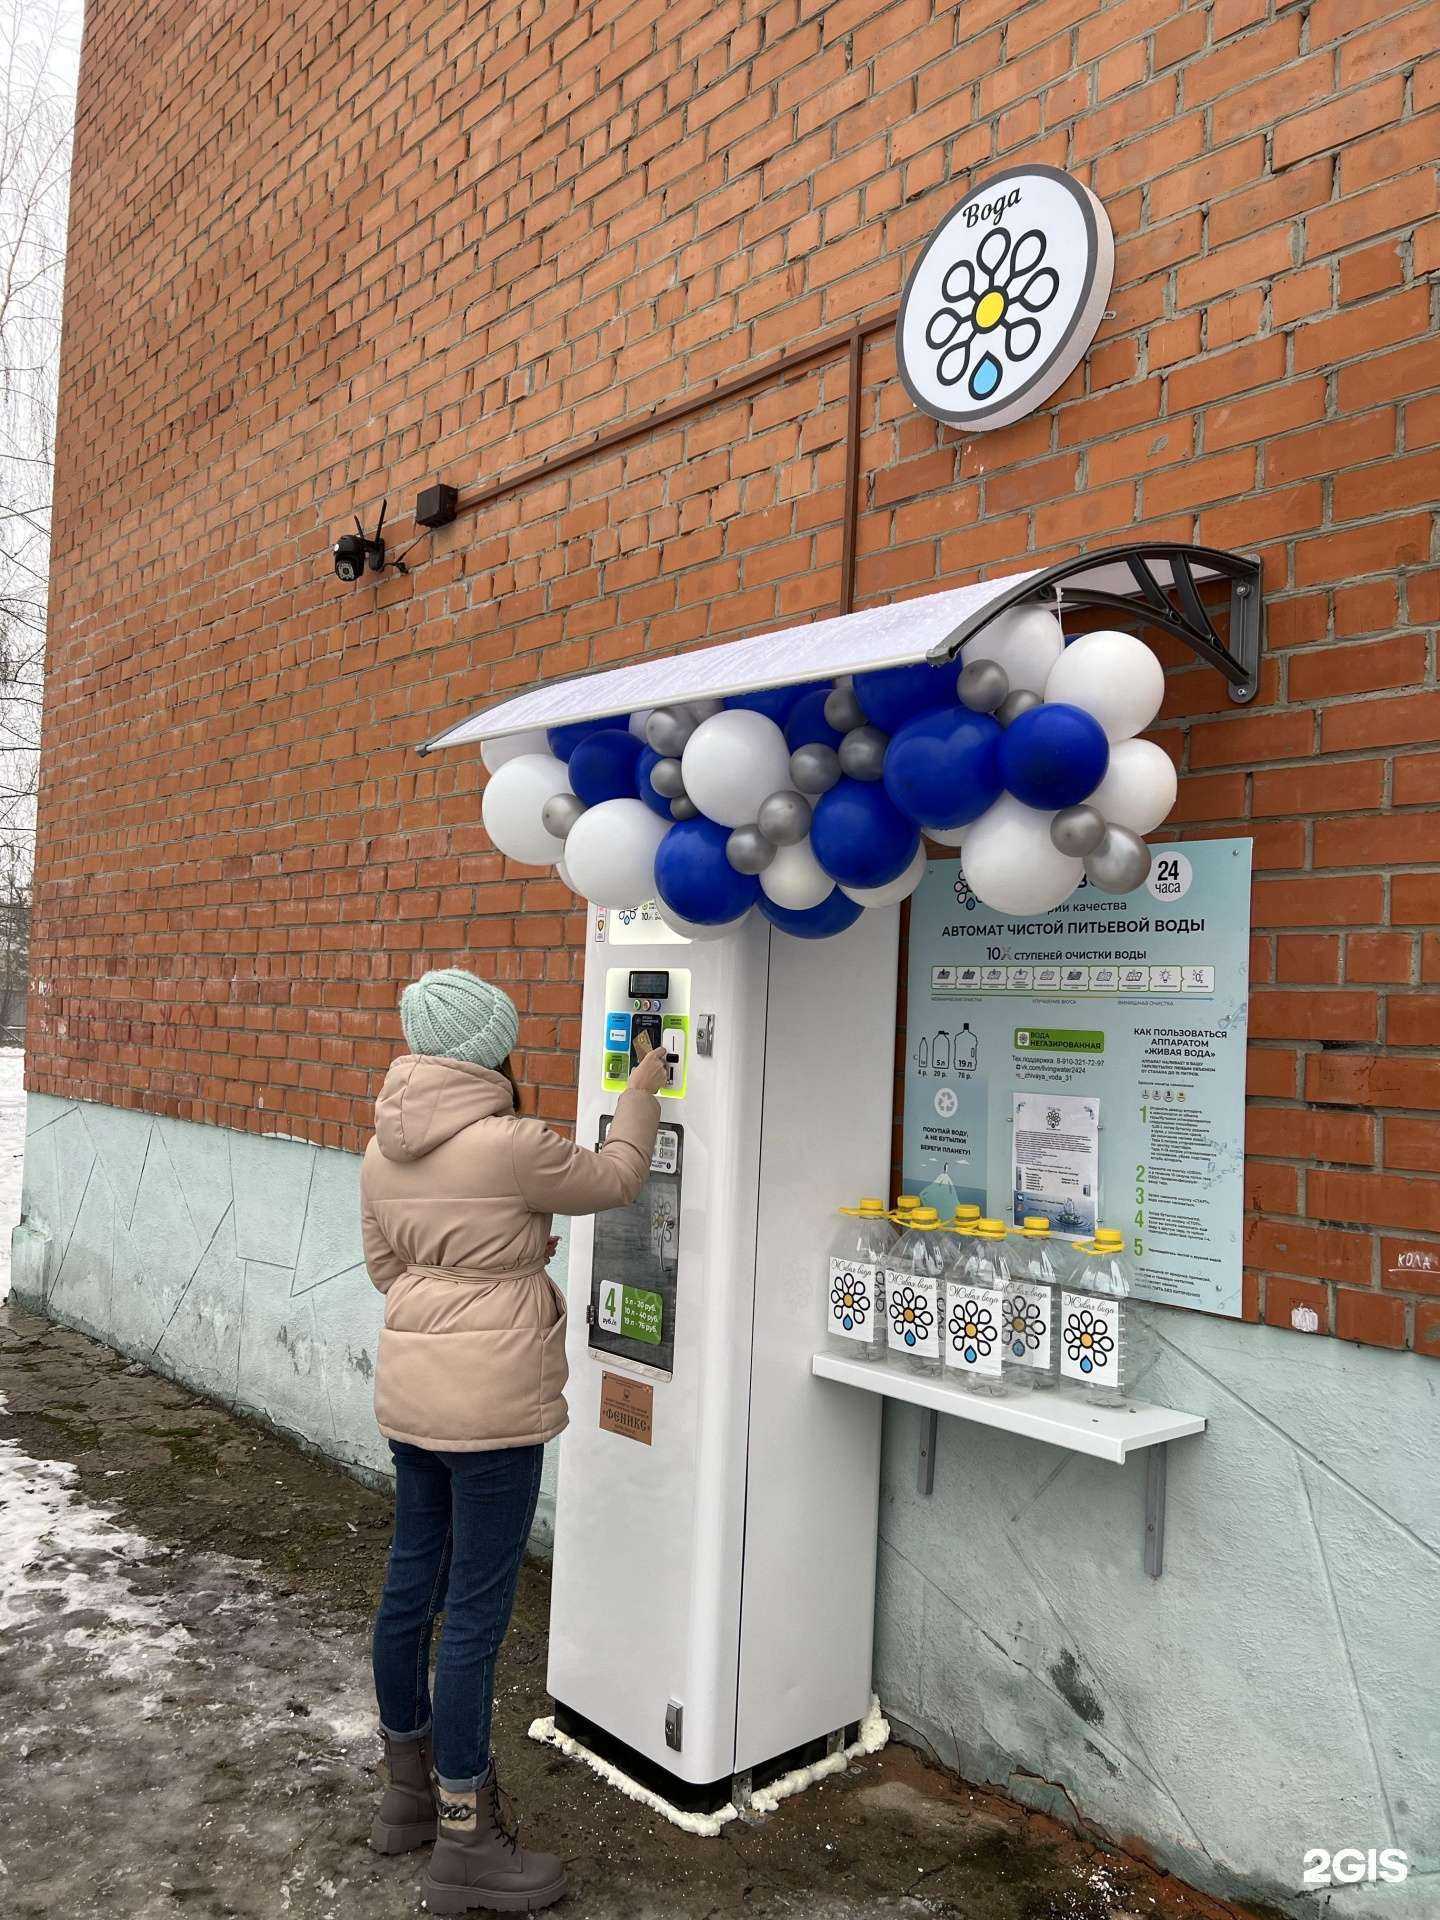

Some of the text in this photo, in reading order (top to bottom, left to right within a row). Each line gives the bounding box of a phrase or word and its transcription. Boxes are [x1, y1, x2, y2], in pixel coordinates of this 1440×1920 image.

[1158, 860, 1179, 881] 24
[1155, 882, 1180, 894] часа
[1073, 902, 1126, 912] качества
[942, 918, 1204, 936] АВТОМАТ ЧИСТОЙ ПИТЬЕВОЙ ВОДЫ
[1014, 950, 1062, 960] СТУПЕНЕЙ
[1066, 950, 1112, 960] ОЧИСТКИ
[1114, 951, 1146, 960] ВОДЫ
[1134, 1028, 1227, 1038] КАК ПОЛЬЗОВАТЬСЯ
[1030, 1040, 1101, 1049] НЕГАЗИРОВАННАЯ
[1151, 1038, 1208, 1047] АППАРАТОМ
[1144, 1048, 1216, 1058] «ЖИВАЯ ВОДА»
[1140, 1106, 1146, 1123] 1
[923, 1126, 950, 1135] ПОКУПАЙ
[921, 1144, 970, 1156] БЕРЕГИ ПЛАНЕТУ!
[1136, 1165, 1145, 1182] 2
[1136, 1188, 1144, 1204] 3
[1135, 1210, 1144, 1228] 4
[1134, 1239, 1142, 1256] 5
[605, 1287, 616, 1317] 4
[624, 1306, 630, 1315] 10
[639, 1311, 646, 1320] 40
